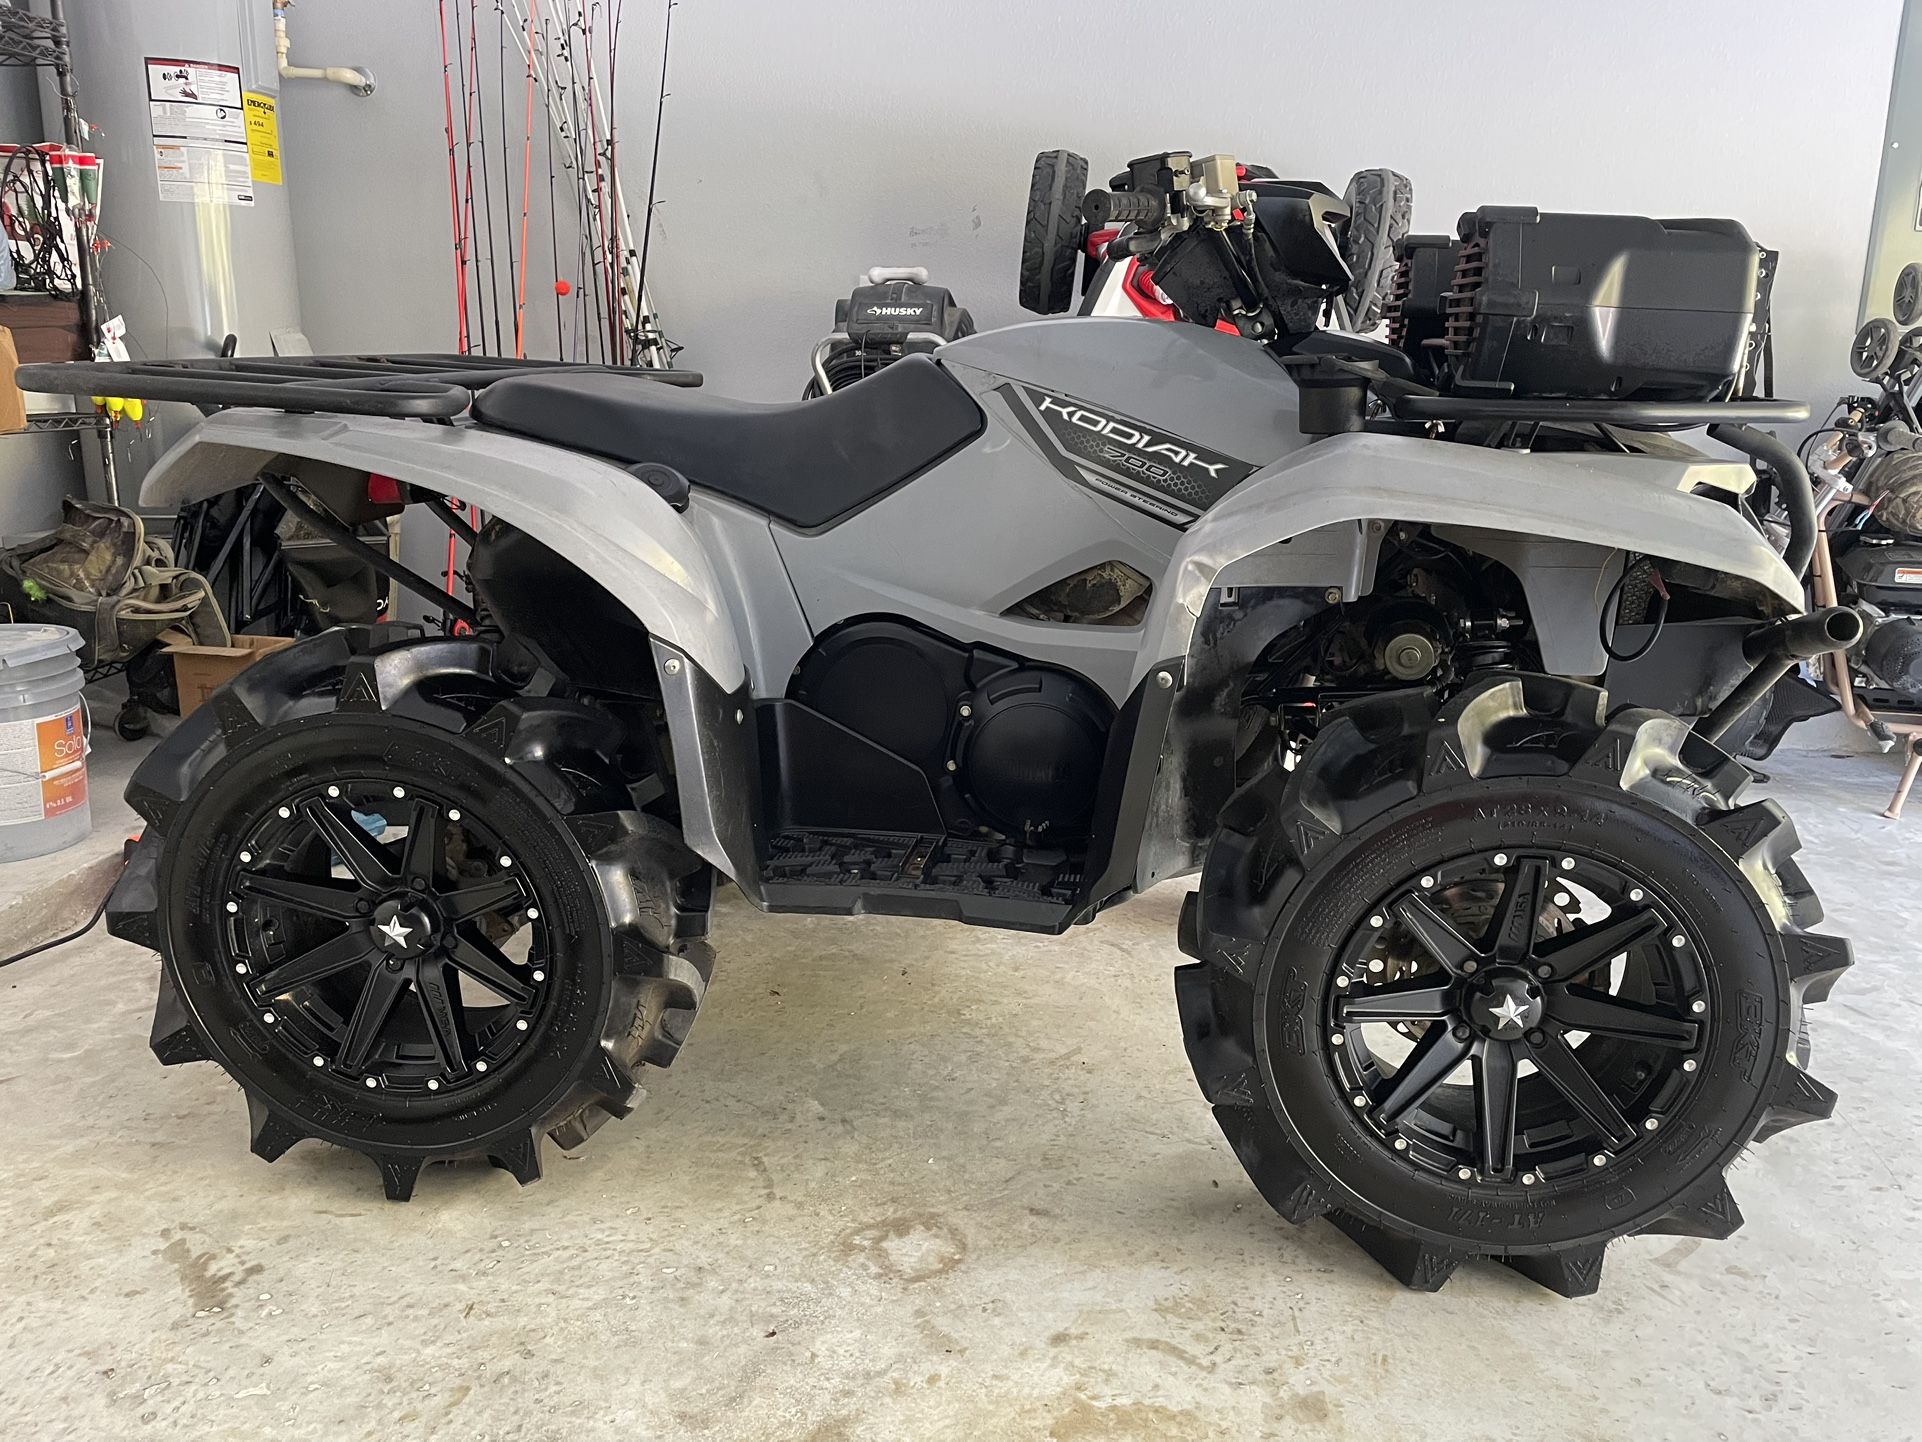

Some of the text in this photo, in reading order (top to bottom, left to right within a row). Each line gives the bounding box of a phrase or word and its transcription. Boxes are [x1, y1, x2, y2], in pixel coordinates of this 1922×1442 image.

[881, 307, 924, 316] HUSKY
[1038, 396, 1230, 479] KODIAK
[1103, 445, 1171, 479] 700
[1095, 477, 1179, 517] POWER STEERING
[54, 735, 82, 758] Solo
